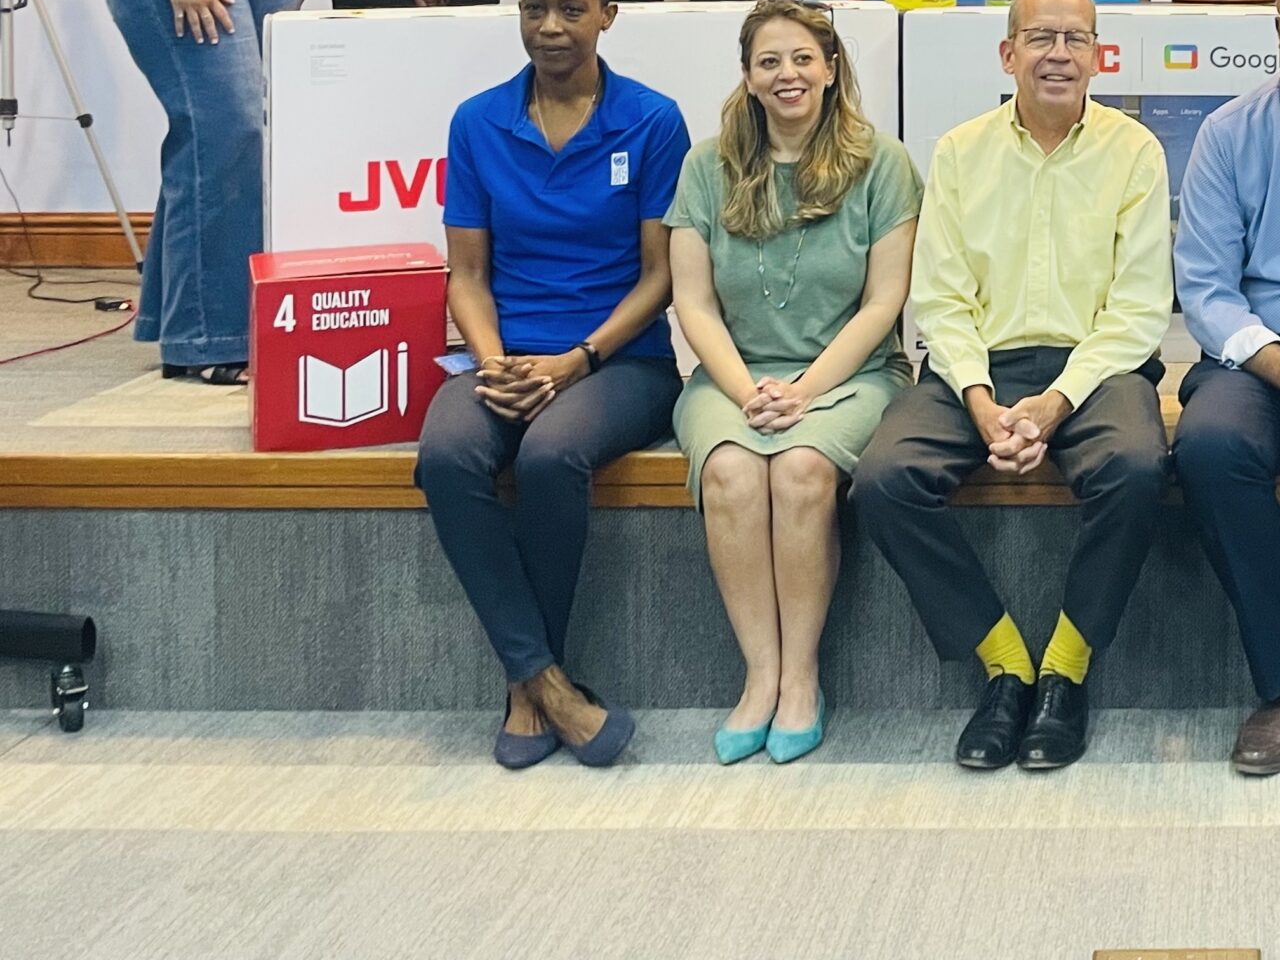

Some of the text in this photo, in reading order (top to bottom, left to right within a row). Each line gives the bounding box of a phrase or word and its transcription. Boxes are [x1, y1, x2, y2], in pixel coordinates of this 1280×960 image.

[1152, 108, 1203, 117] Apps Library
[312, 289, 371, 312] QUALITY
[273, 294, 296, 333] 4
[312, 308, 390, 331] EDUCATION
